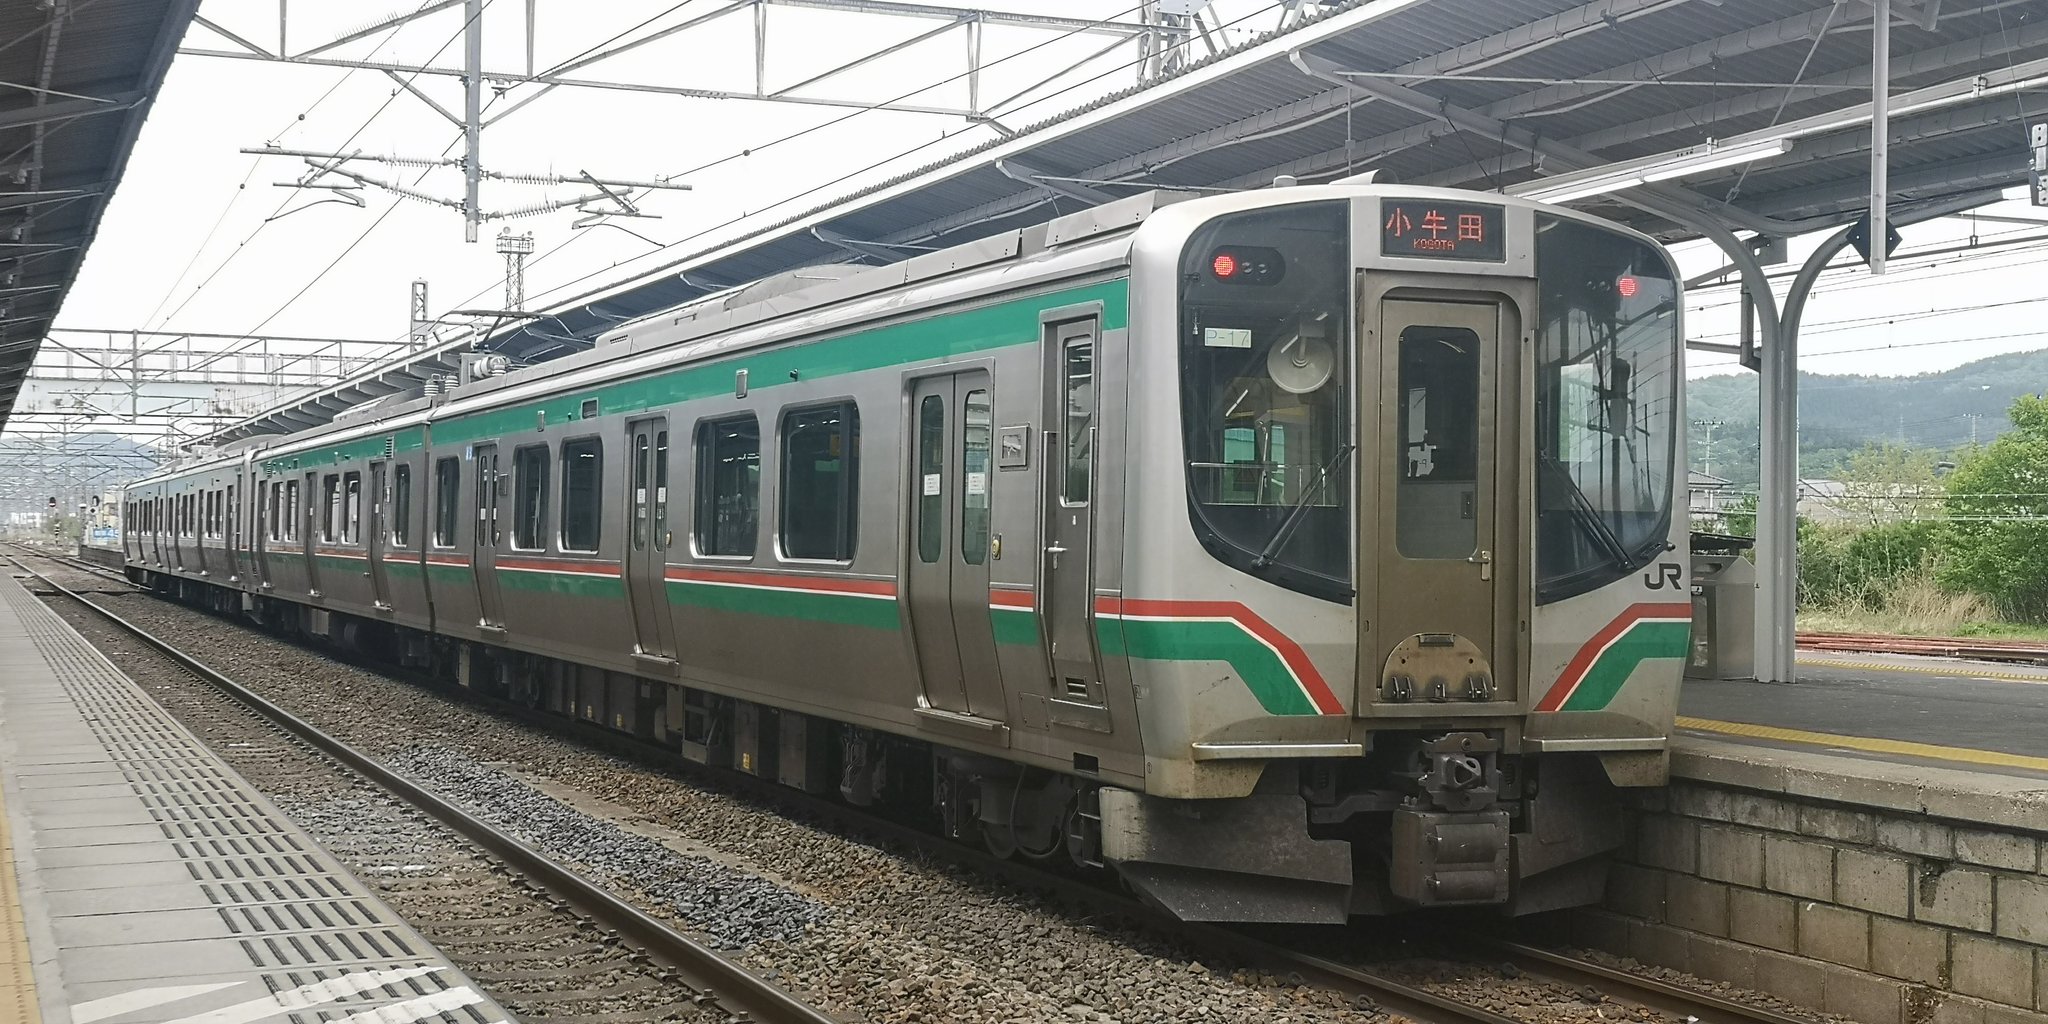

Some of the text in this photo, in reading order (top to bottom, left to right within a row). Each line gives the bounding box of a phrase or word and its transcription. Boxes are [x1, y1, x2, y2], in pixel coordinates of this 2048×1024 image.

[1385, 207, 1482, 241] 小牛田
[1206, 329, 1250, 346] P-17
[1644, 563, 1682, 590] JR
